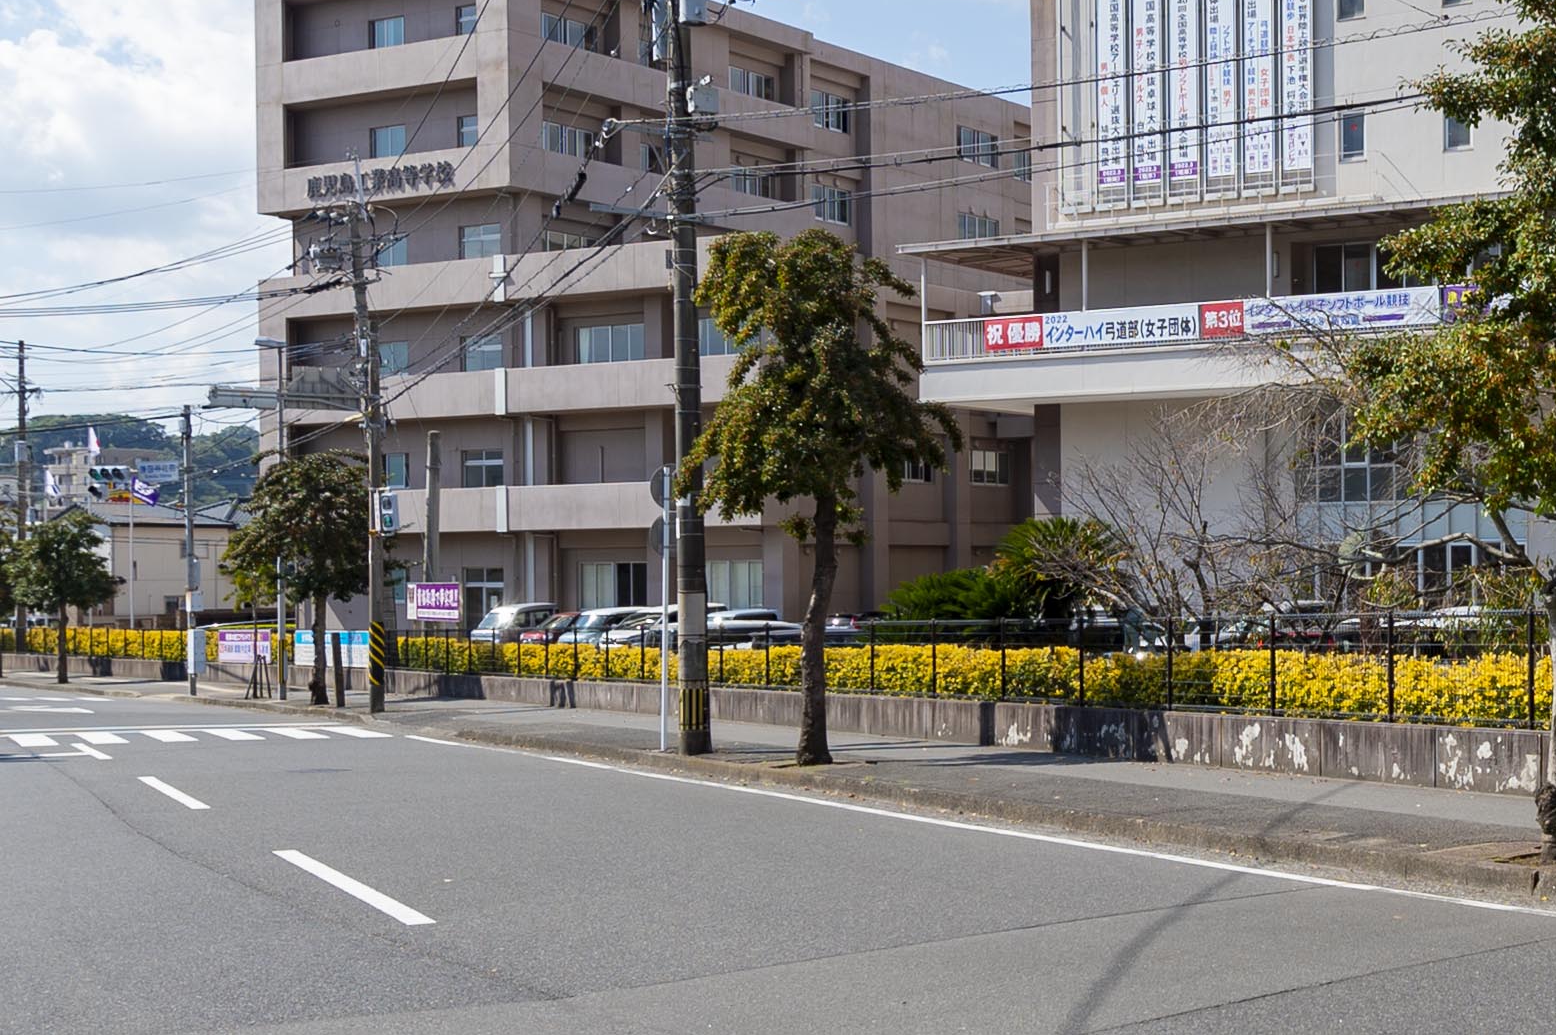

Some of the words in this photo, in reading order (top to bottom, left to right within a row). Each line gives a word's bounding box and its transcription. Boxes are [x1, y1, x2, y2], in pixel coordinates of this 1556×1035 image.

[1045, 315, 1068, 324] 2022
[1045, 316, 1197, 344] インターハイ弓道部(女子団体)
[1204, 309, 1243, 329] 第3位
[987, 324, 1004, 345] 祝
[1007, 321, 1041, 343] 優勝
